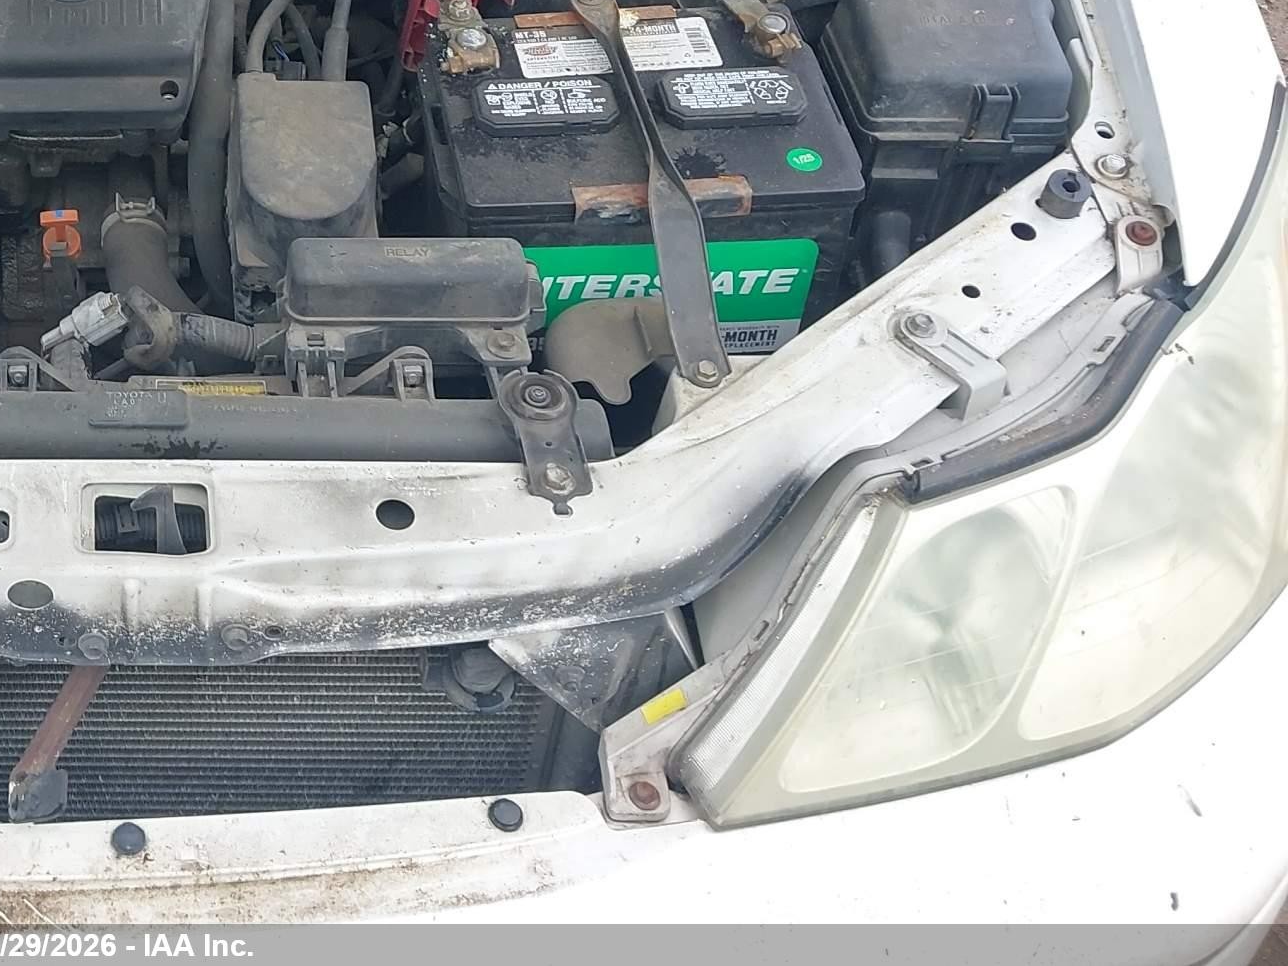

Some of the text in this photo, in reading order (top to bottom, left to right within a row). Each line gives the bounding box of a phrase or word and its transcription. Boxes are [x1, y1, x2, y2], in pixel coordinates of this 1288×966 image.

[497, 81, 542, 89] DANGER
[552, 79, 592, 87] POISON
[385, 247, 430, 257] RELAY
